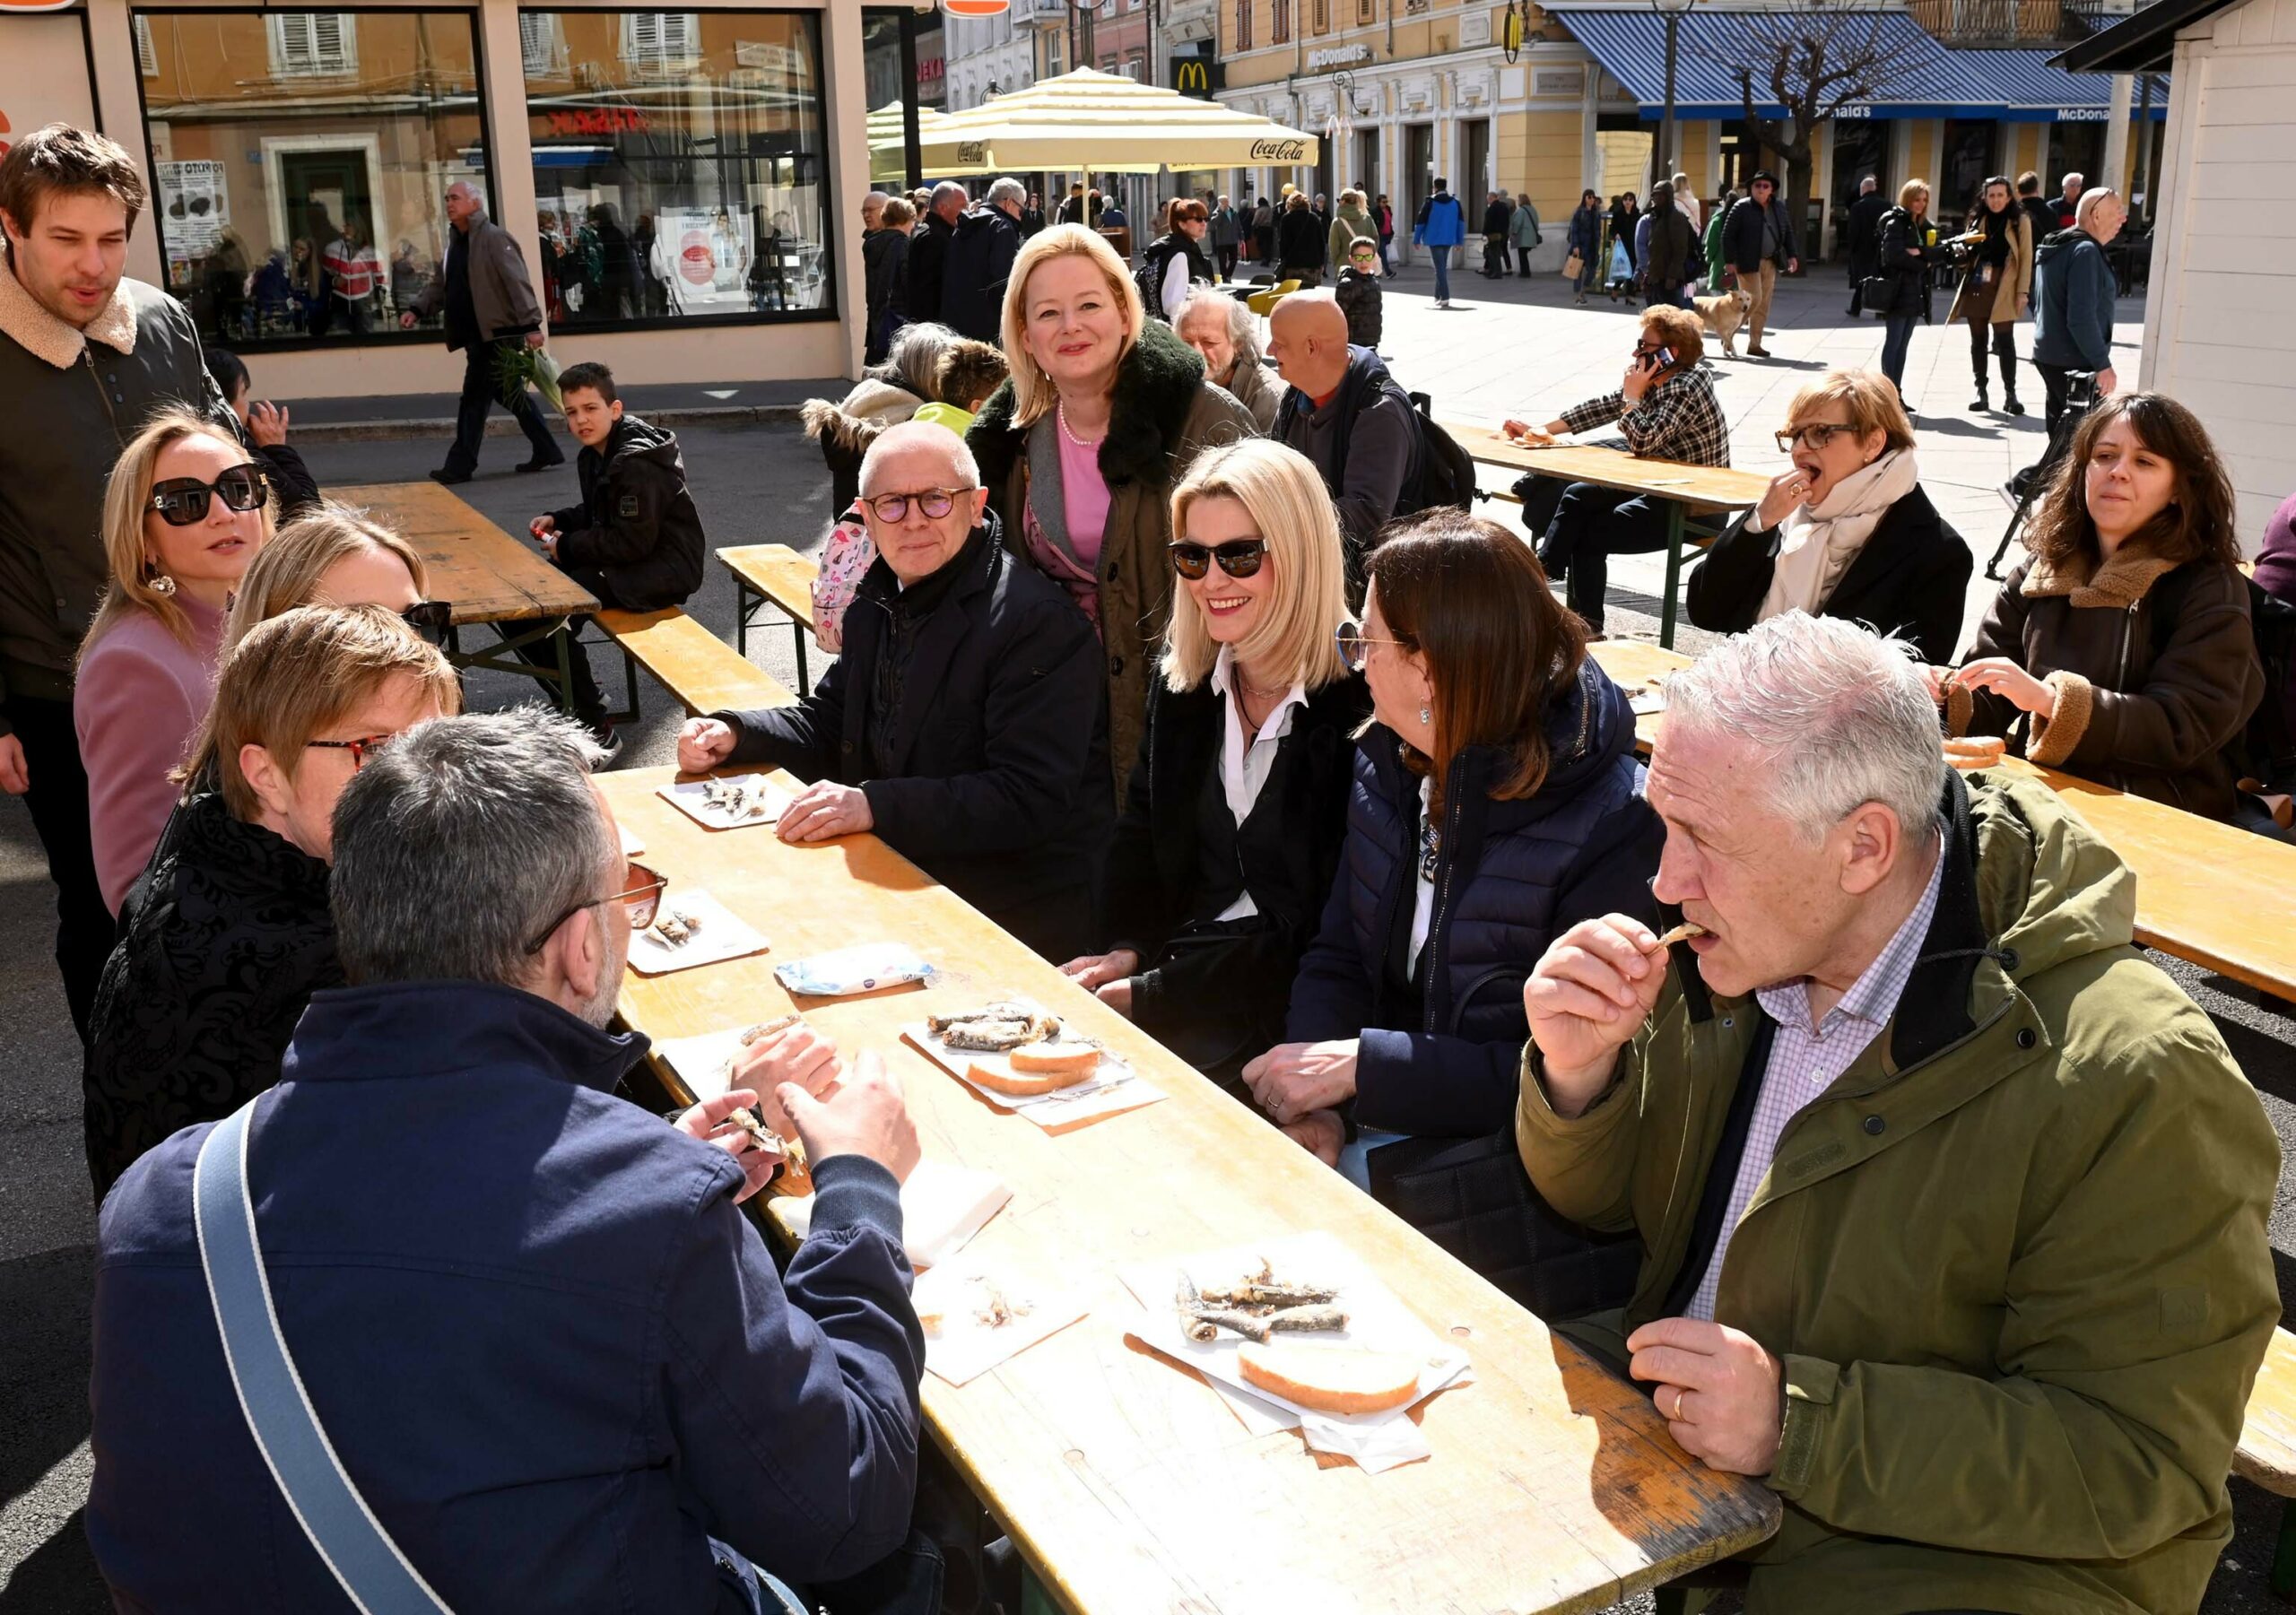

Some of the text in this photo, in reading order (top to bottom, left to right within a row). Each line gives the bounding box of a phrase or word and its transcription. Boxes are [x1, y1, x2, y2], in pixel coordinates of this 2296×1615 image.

[1308, 43, 1365, 67] McDonald's
[917, 58, 944, 82] JEKA
[2057, 109, 2110, 120] McDona
